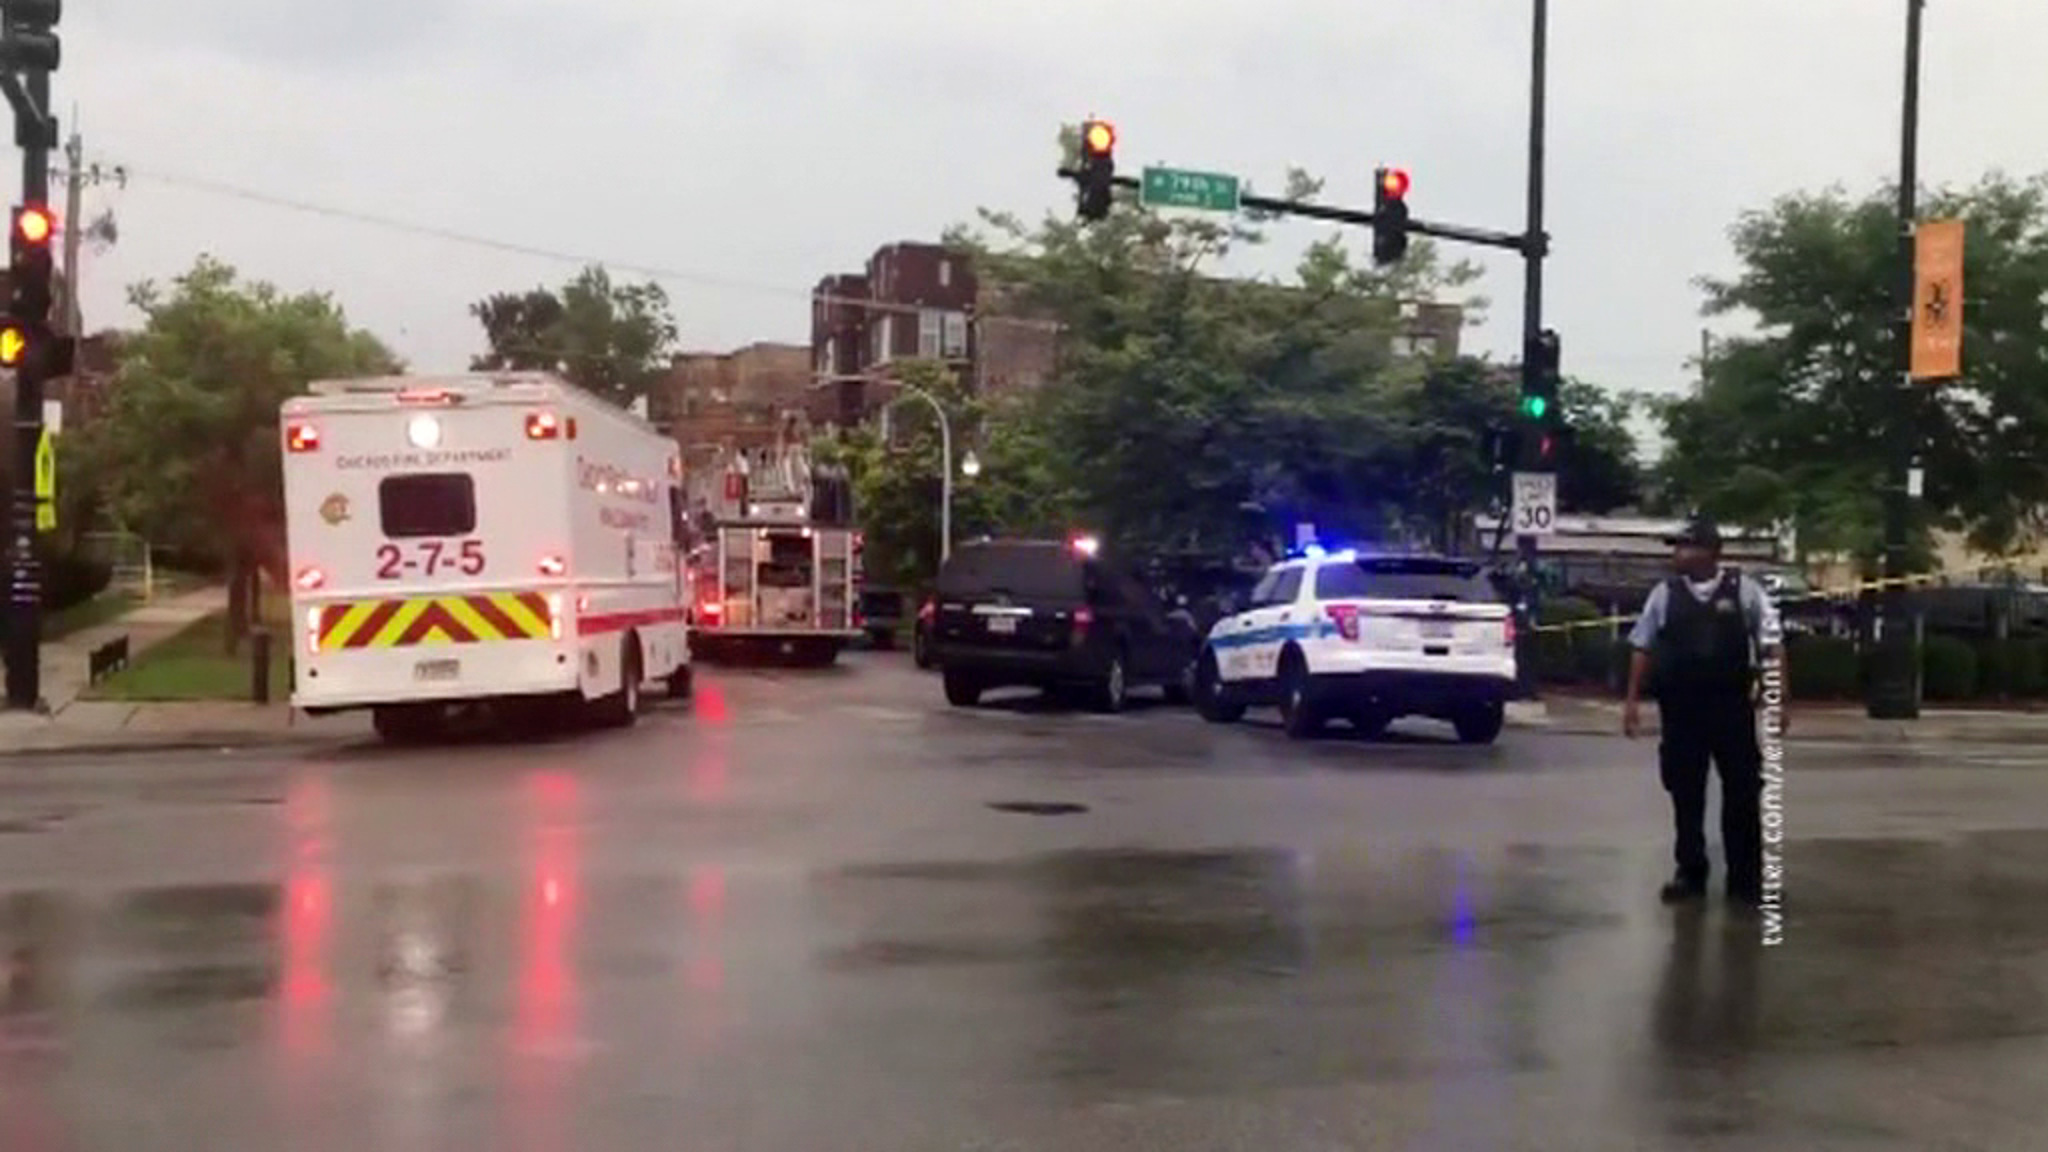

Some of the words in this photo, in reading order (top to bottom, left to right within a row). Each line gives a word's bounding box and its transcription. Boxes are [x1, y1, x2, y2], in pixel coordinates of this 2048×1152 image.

[336, 454, 391, 470] CHICAGO
[393, 452, 420, 468] FIRE
[426, 448, 512, 465] DEPARTMENT
[1520, 505, 1551, 529] 30
[376, 540, 485, 580] 2-7-5
